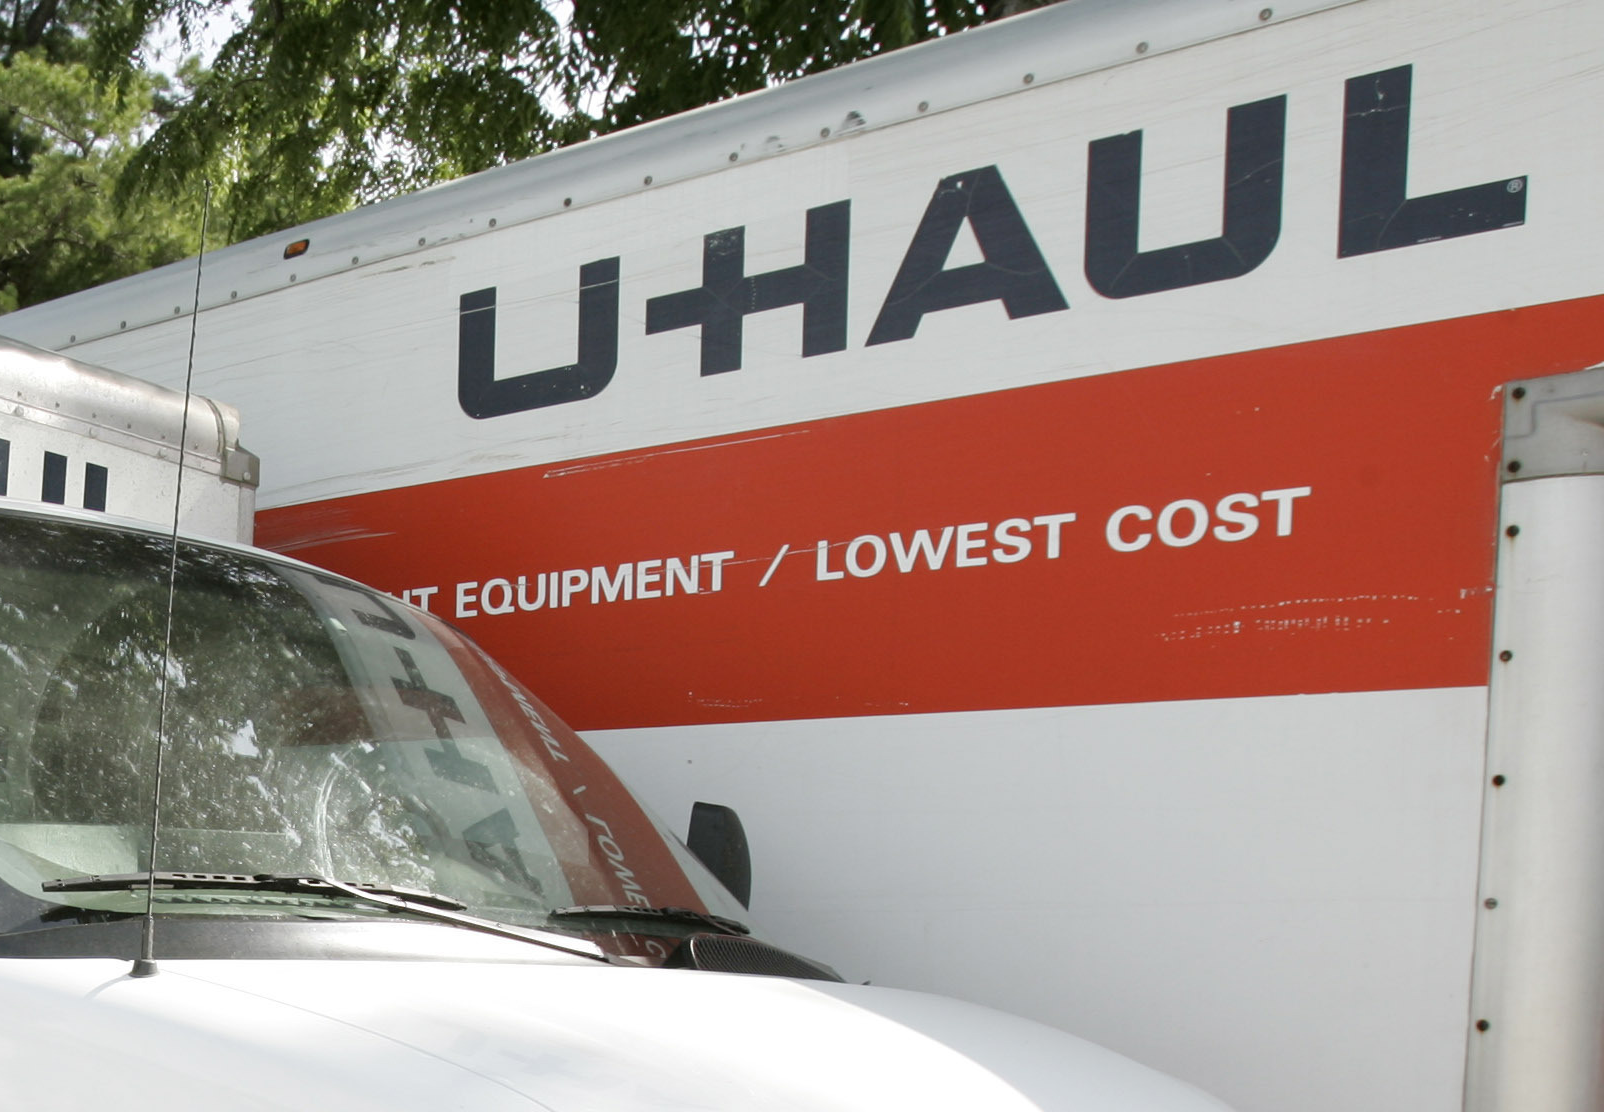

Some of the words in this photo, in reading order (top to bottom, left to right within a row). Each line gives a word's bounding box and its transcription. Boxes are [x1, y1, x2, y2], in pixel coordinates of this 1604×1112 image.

[456, 550, 734, 618] EQUIPMENT
[815, 513, 1077, 582] LOWEST
[1105, 486, 1312, 553] COST
